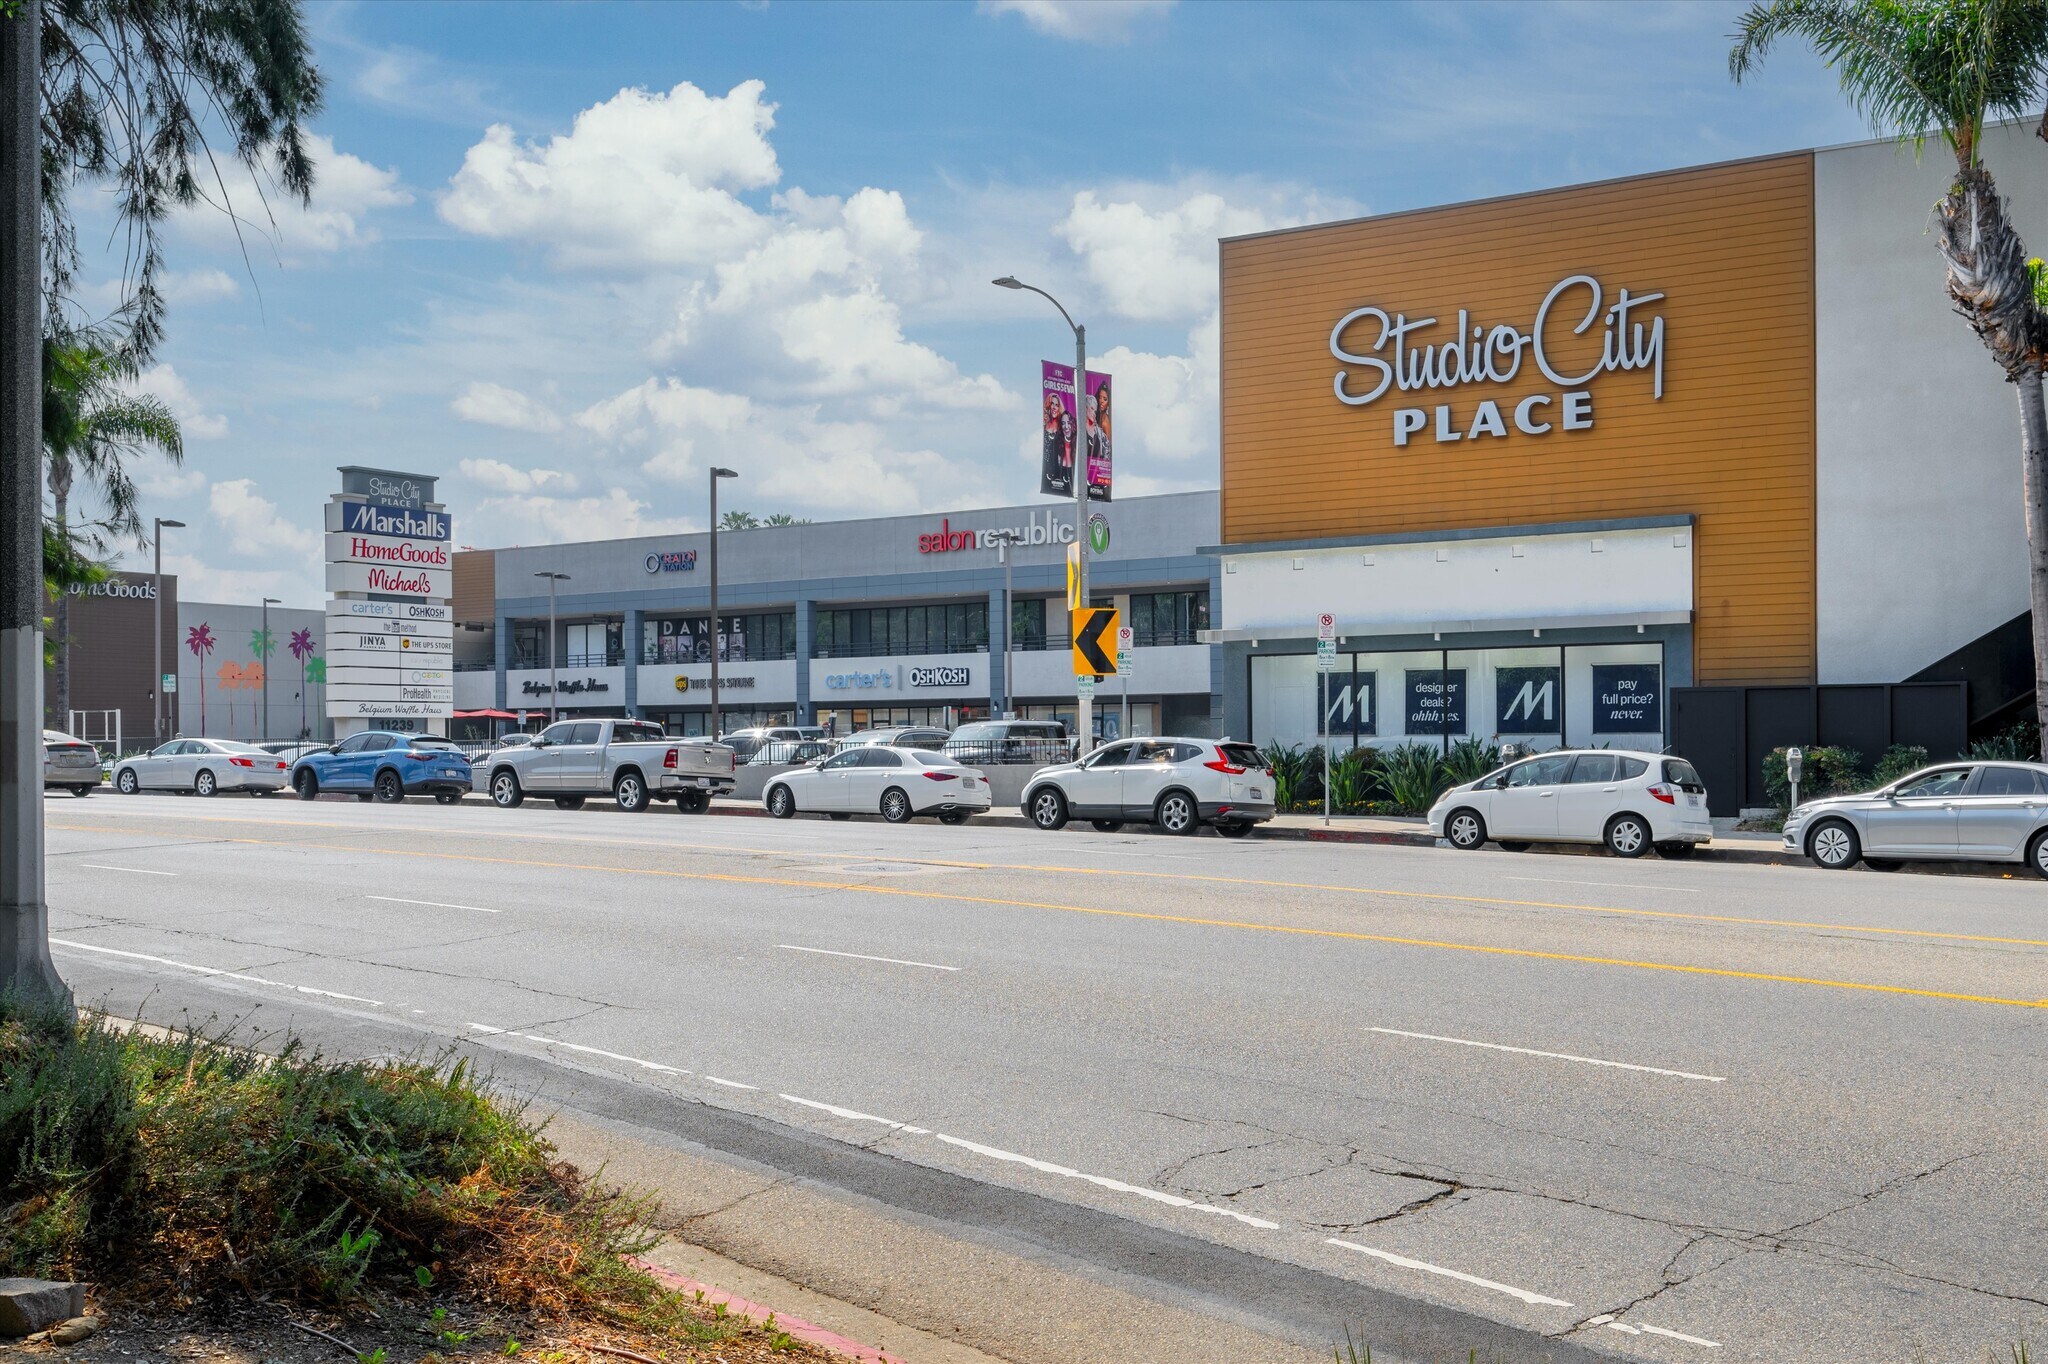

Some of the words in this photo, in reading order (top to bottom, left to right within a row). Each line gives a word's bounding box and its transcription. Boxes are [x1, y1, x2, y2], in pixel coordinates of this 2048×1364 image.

[1329, 307, 1531, 405] Studio
[1533, 275, 1665, 399] City
[1393, 391, 1594, 446] PLACE
[369, 478, 400, 497] Studio
[401, 480, 420, 508] City
[381, 497, 411, 508] PLACE
[351, 506, 446, 538] Marshalls
[350, 537, 447, 564] HomeGoods
[67, 579, 157, 599] omeGoods
[351, 603, 393, 615] carter's
[409, 606, 445, 618] OSHKOSH
[360, 635, 386, 649] JINYA
[423, 641, 434, 649] UPS
[435, 642, 452, 650] STORE
[690, 679, 706, 689] THE
[727, 677, 755, 689] STORE
[825, 668, 892, 689] carter's
[909, 667, 970, 687] OSHKOSH
[1617, 680, 1638, 691] pay
[403, 688, 432, 700] ProHealth
[1601, 693, 1619, 704] full
[1620, 693, 1653, 706] price?
[395, 703, 420, 715] Waffle
[421, 703, 442, 714] Haus
[1610, 709, 1643, 719] never.
[1412, 710, 1438, 722] ohhh
[379, 719, 414, 731] 11239
